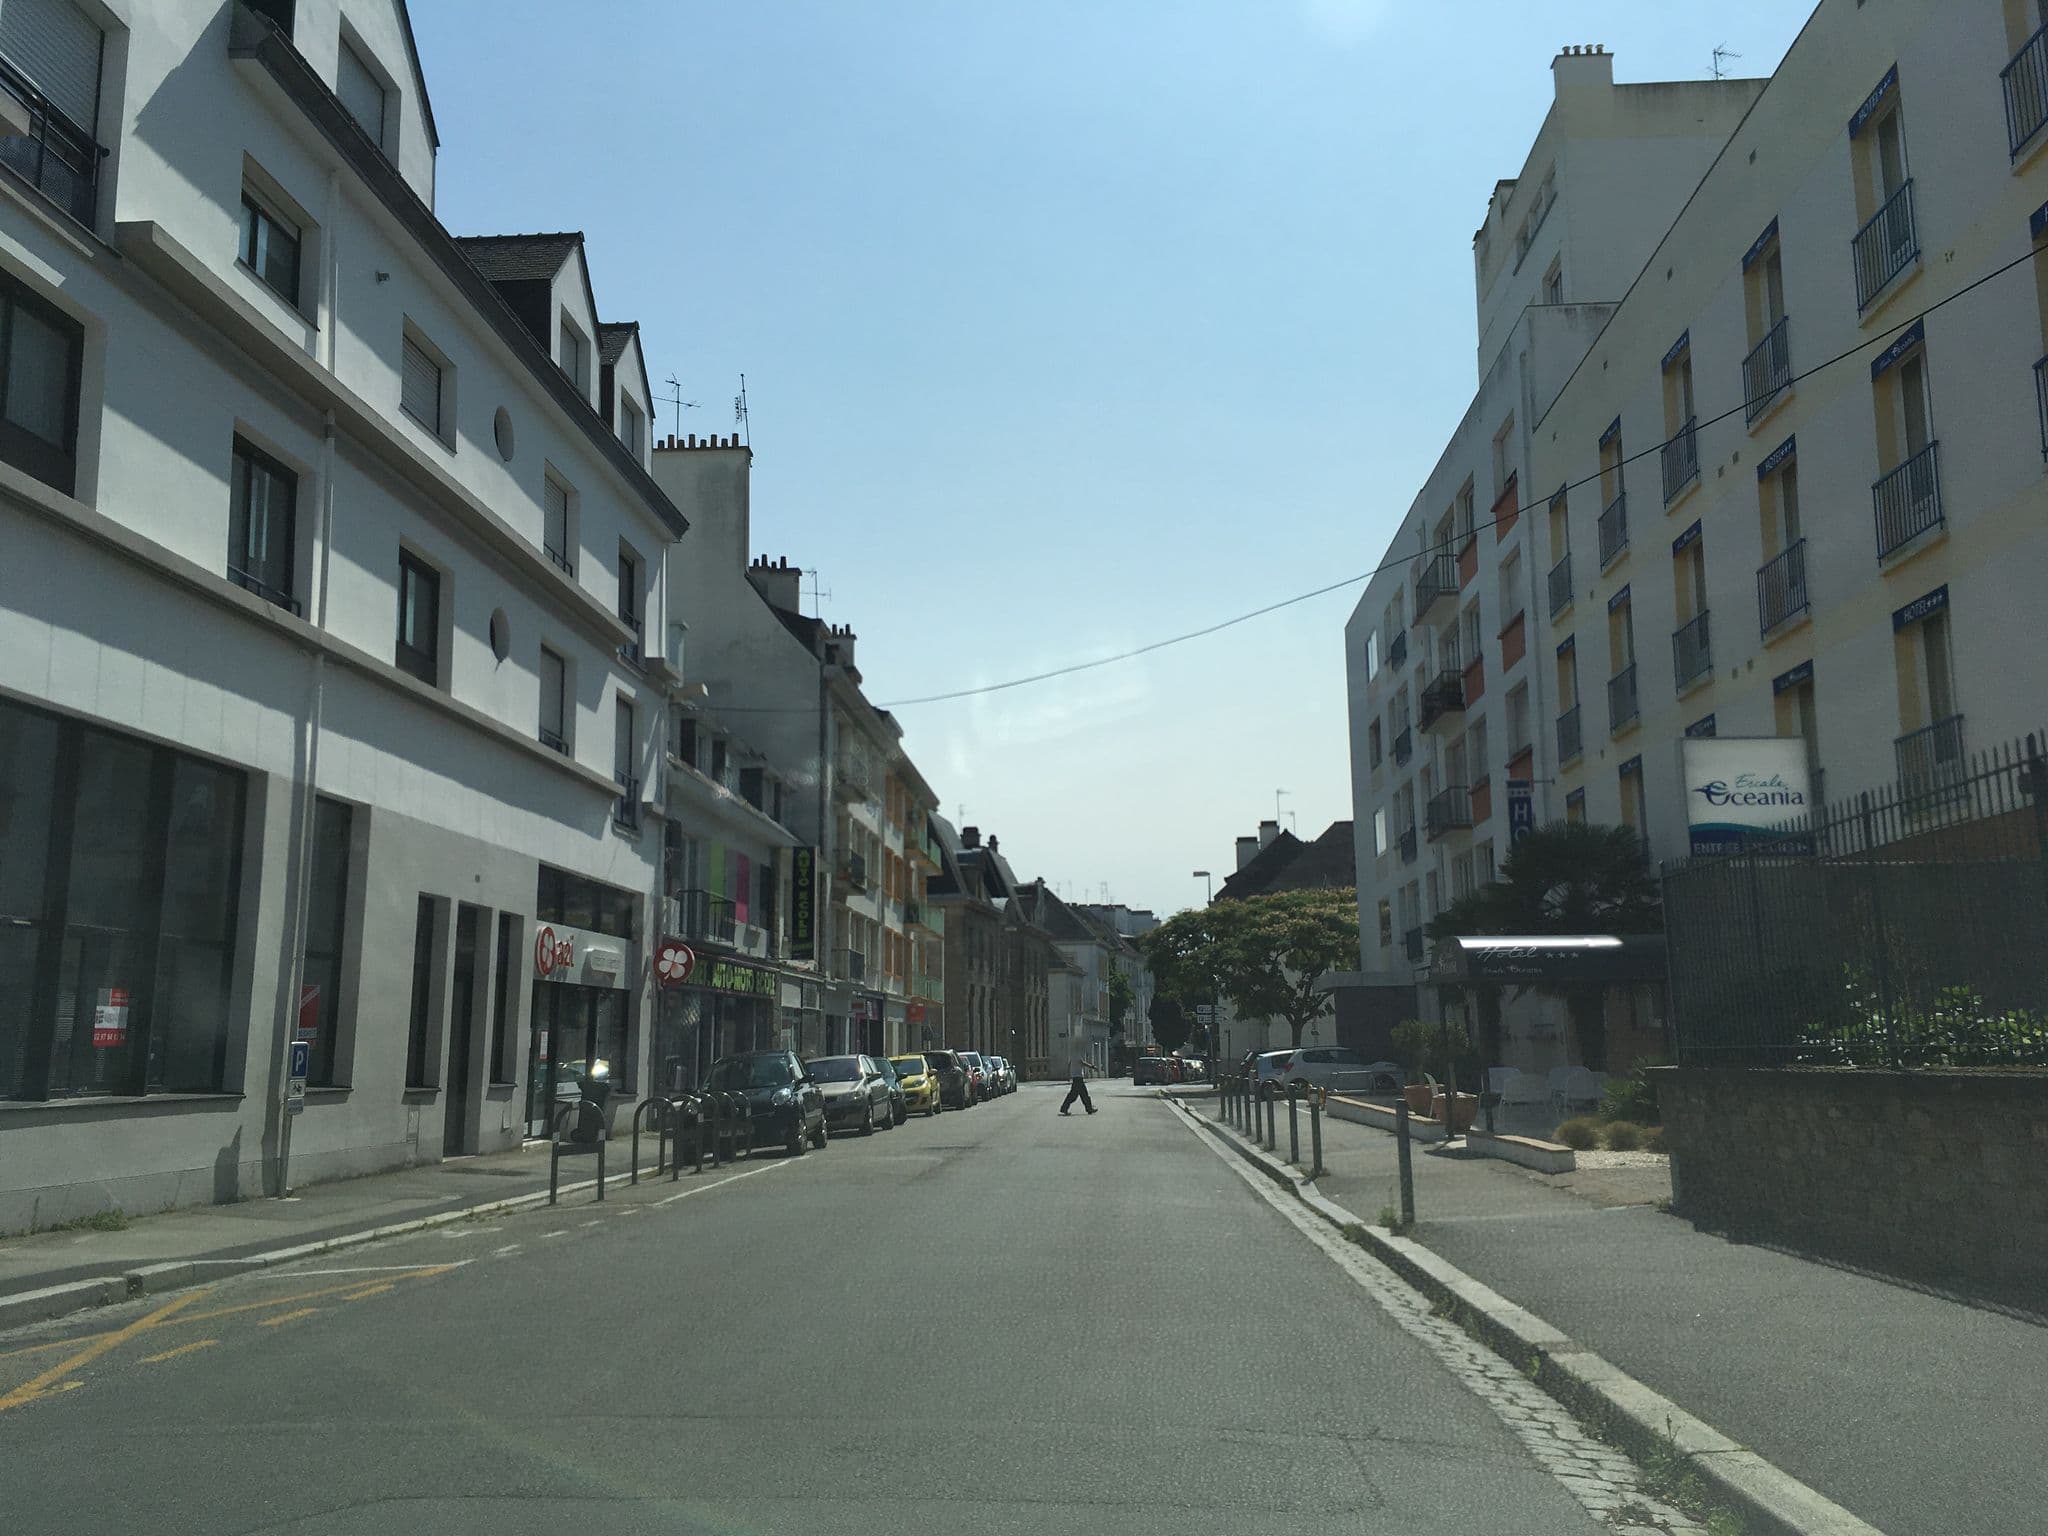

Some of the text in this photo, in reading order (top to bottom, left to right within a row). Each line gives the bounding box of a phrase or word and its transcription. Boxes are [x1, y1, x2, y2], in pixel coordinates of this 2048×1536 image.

[1904, 600, 1927, 624] HOTEL
[1692, 780, 1805, 806] Oceania
[295, 1050, 304, 1072] P
